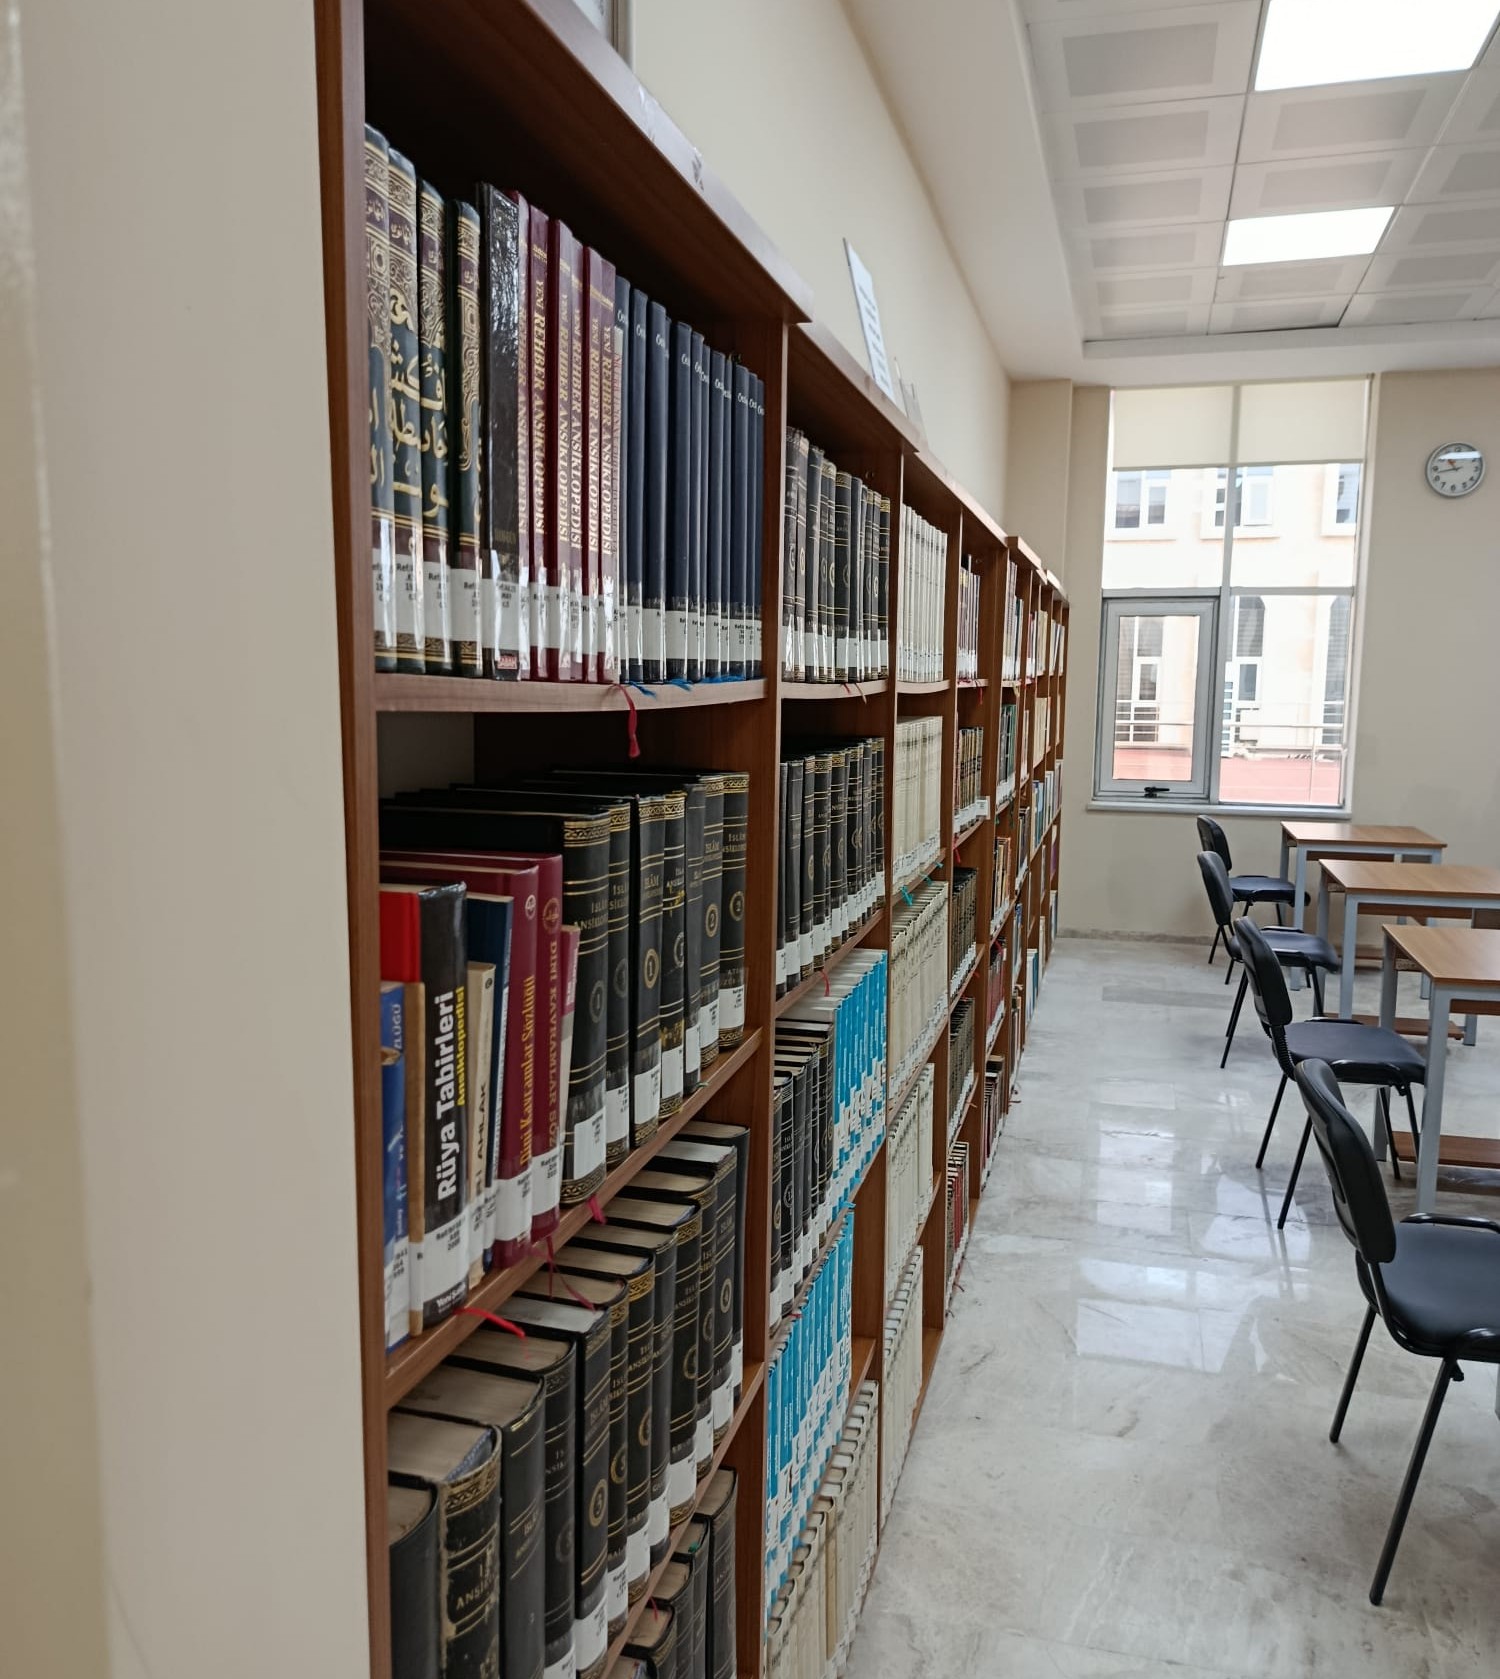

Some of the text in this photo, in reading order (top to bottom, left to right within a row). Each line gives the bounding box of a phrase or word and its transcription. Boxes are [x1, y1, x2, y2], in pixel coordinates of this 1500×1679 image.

[534, 311, 546, 390] REHBER
[559, 326, 569, 401] REHBER
[571, 339, 582, 413] REHBER
[589, 347, 600, 419] REHBER
[601, 356, 613, 426] REHBER
[571, 416, 582, 549] ANSİKLOPEDİSİ
[601, 432, 613, 555] ANSİKLOPEDİSİ
[455, 986, 466, 1107] Ansiklopedisi
[549, 986, 558, 1104] KAVRAMLAR
[434, 991, 460, 1201] Rüya Tabirleri
[477, 1082, 487, 1160] AHLAK
[519, 1043, 534, 1129] Kavramlar
[520, 1128, 532, 1166] Dini
[549, 1111, 558, 1149] SÖZ
